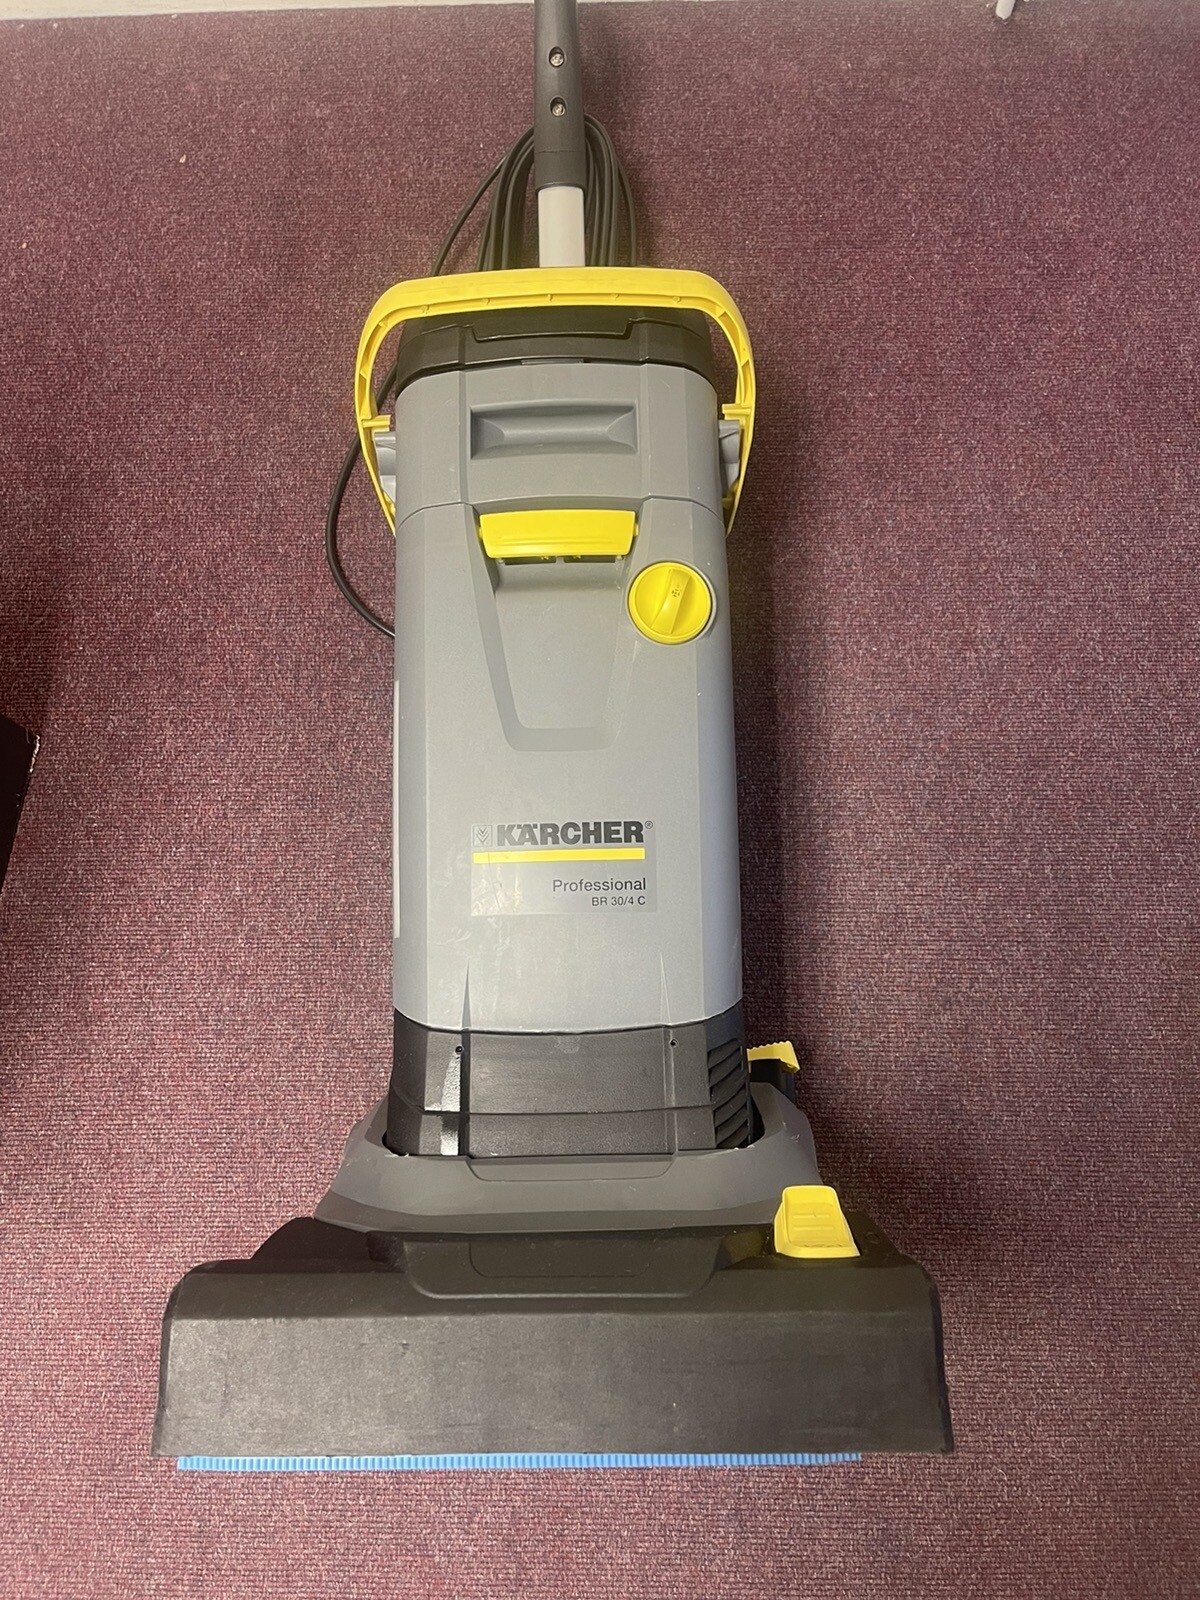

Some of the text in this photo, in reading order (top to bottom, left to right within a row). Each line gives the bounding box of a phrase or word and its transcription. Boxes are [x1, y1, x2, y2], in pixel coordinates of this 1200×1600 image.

[552, 877, 647, 893] Professional
[591, 895, 646, 907] BR 30/4 C
